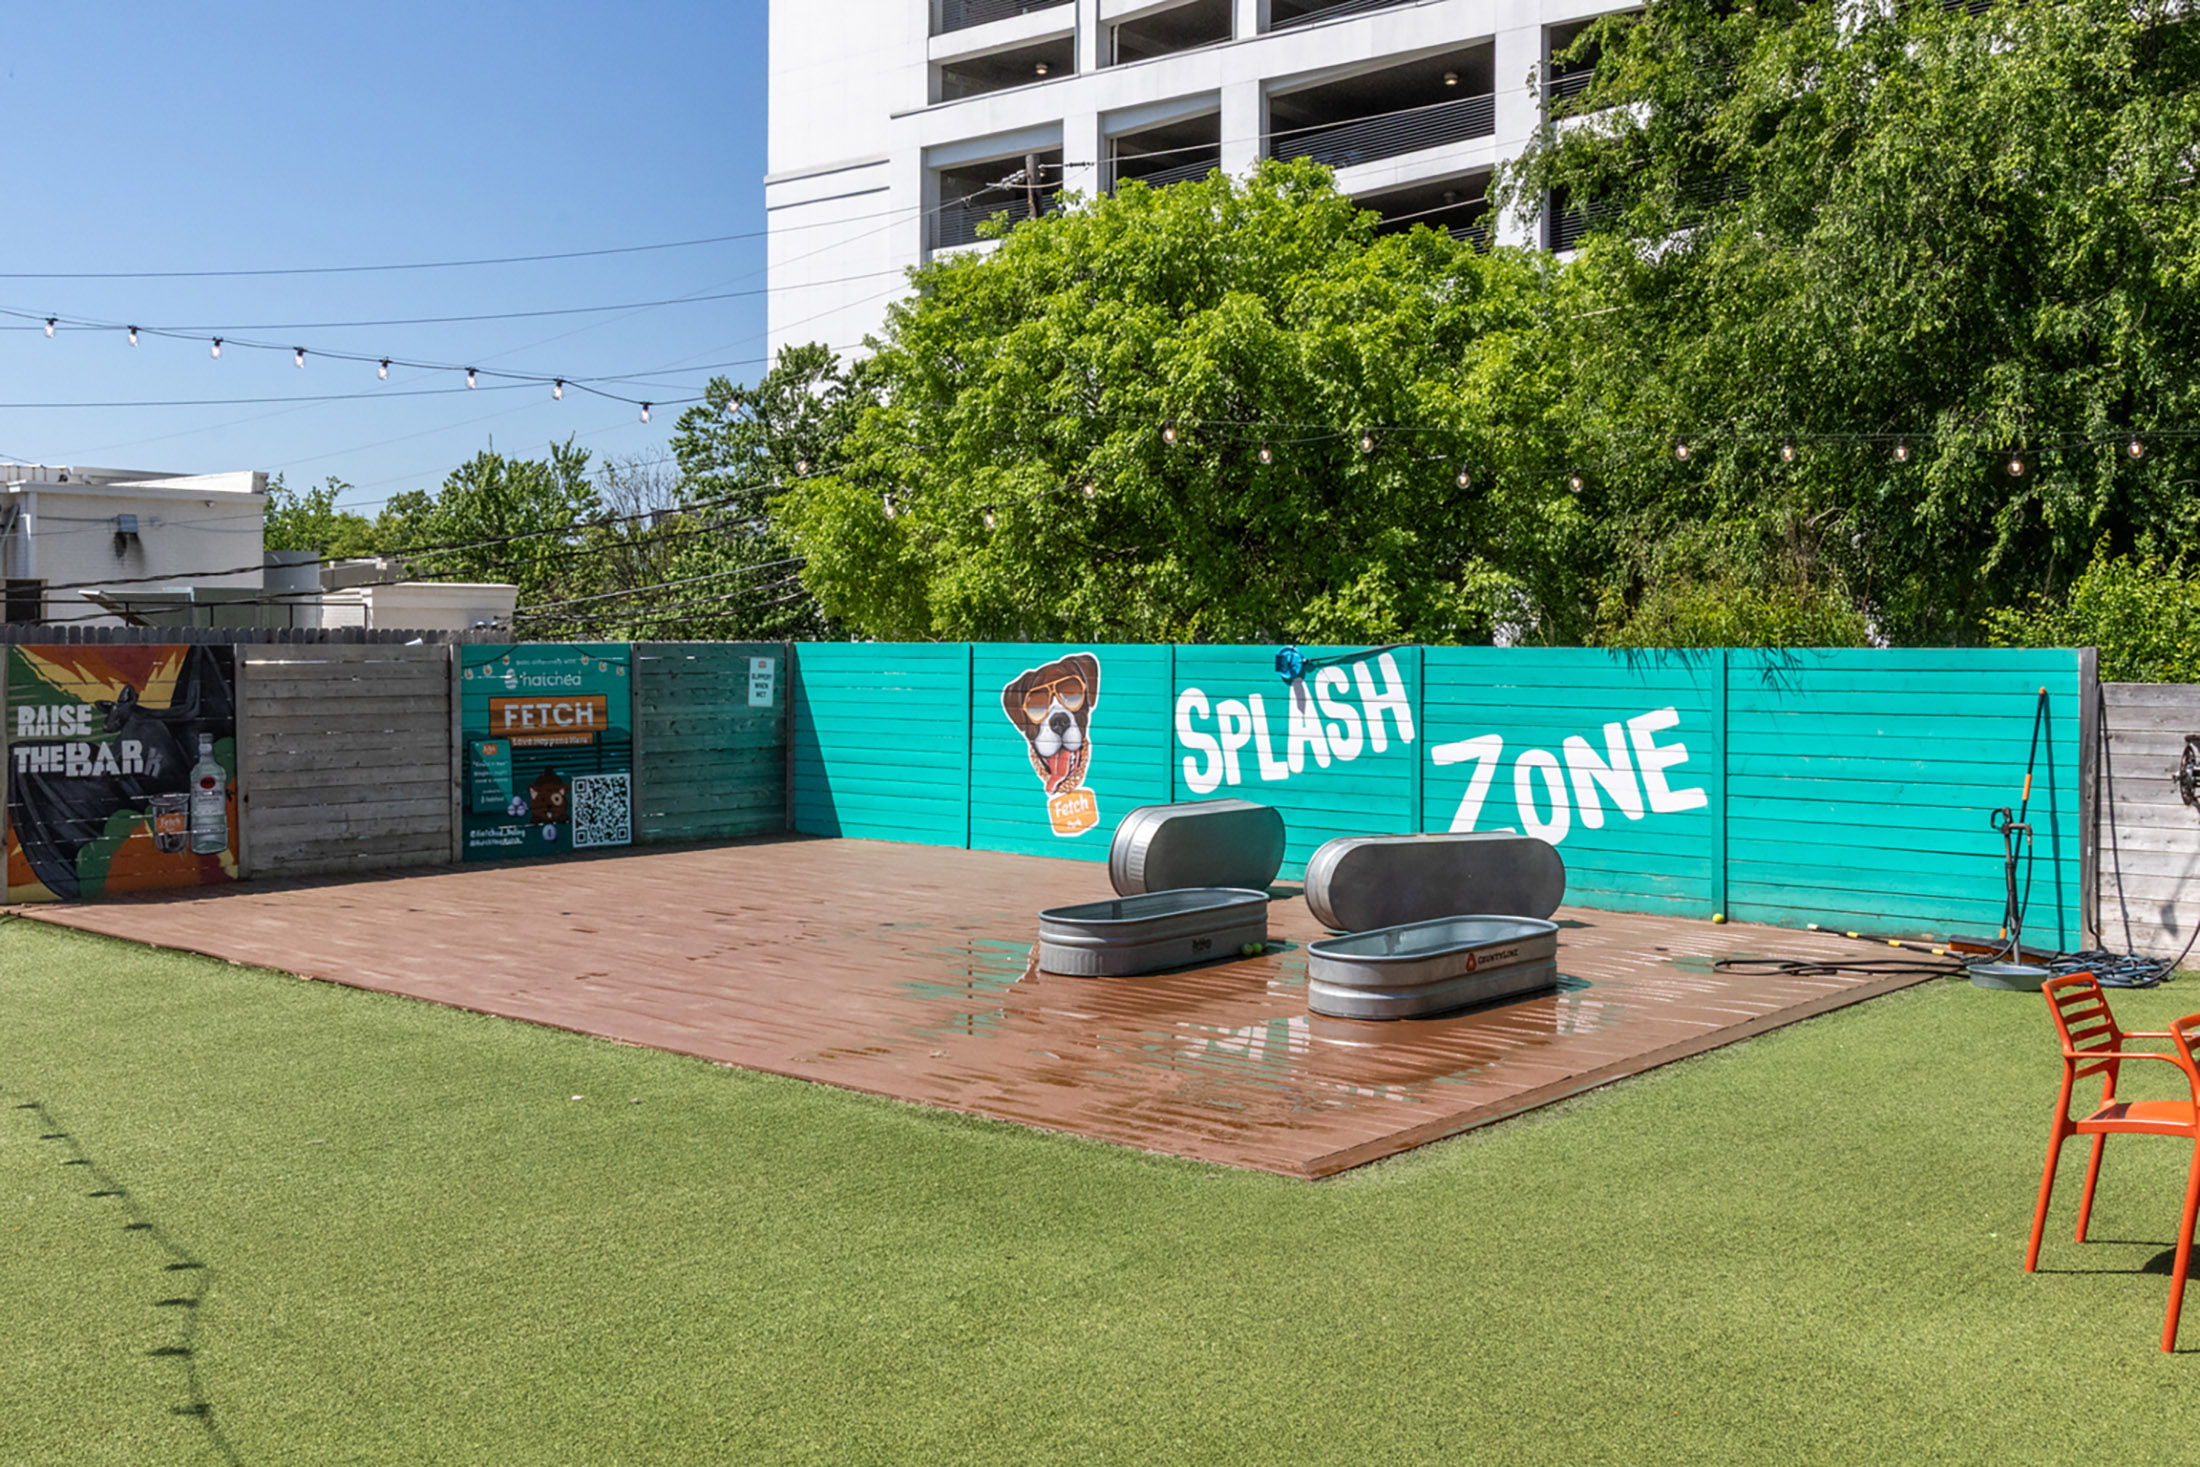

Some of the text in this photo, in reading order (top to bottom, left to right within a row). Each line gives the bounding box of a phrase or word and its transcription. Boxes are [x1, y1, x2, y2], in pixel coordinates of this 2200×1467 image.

[522, 671, 582, 687] hatched
[17, 704, 93, 737] RAISE
[504, 702, 594, 729] FETCH
[1175, 652, 1415, 794] SPLASH
[14, 745, 64, 773] THE
[1431, 706, 1708, 846] ZONE
[1054, 793, 1090, 818] Fetch
